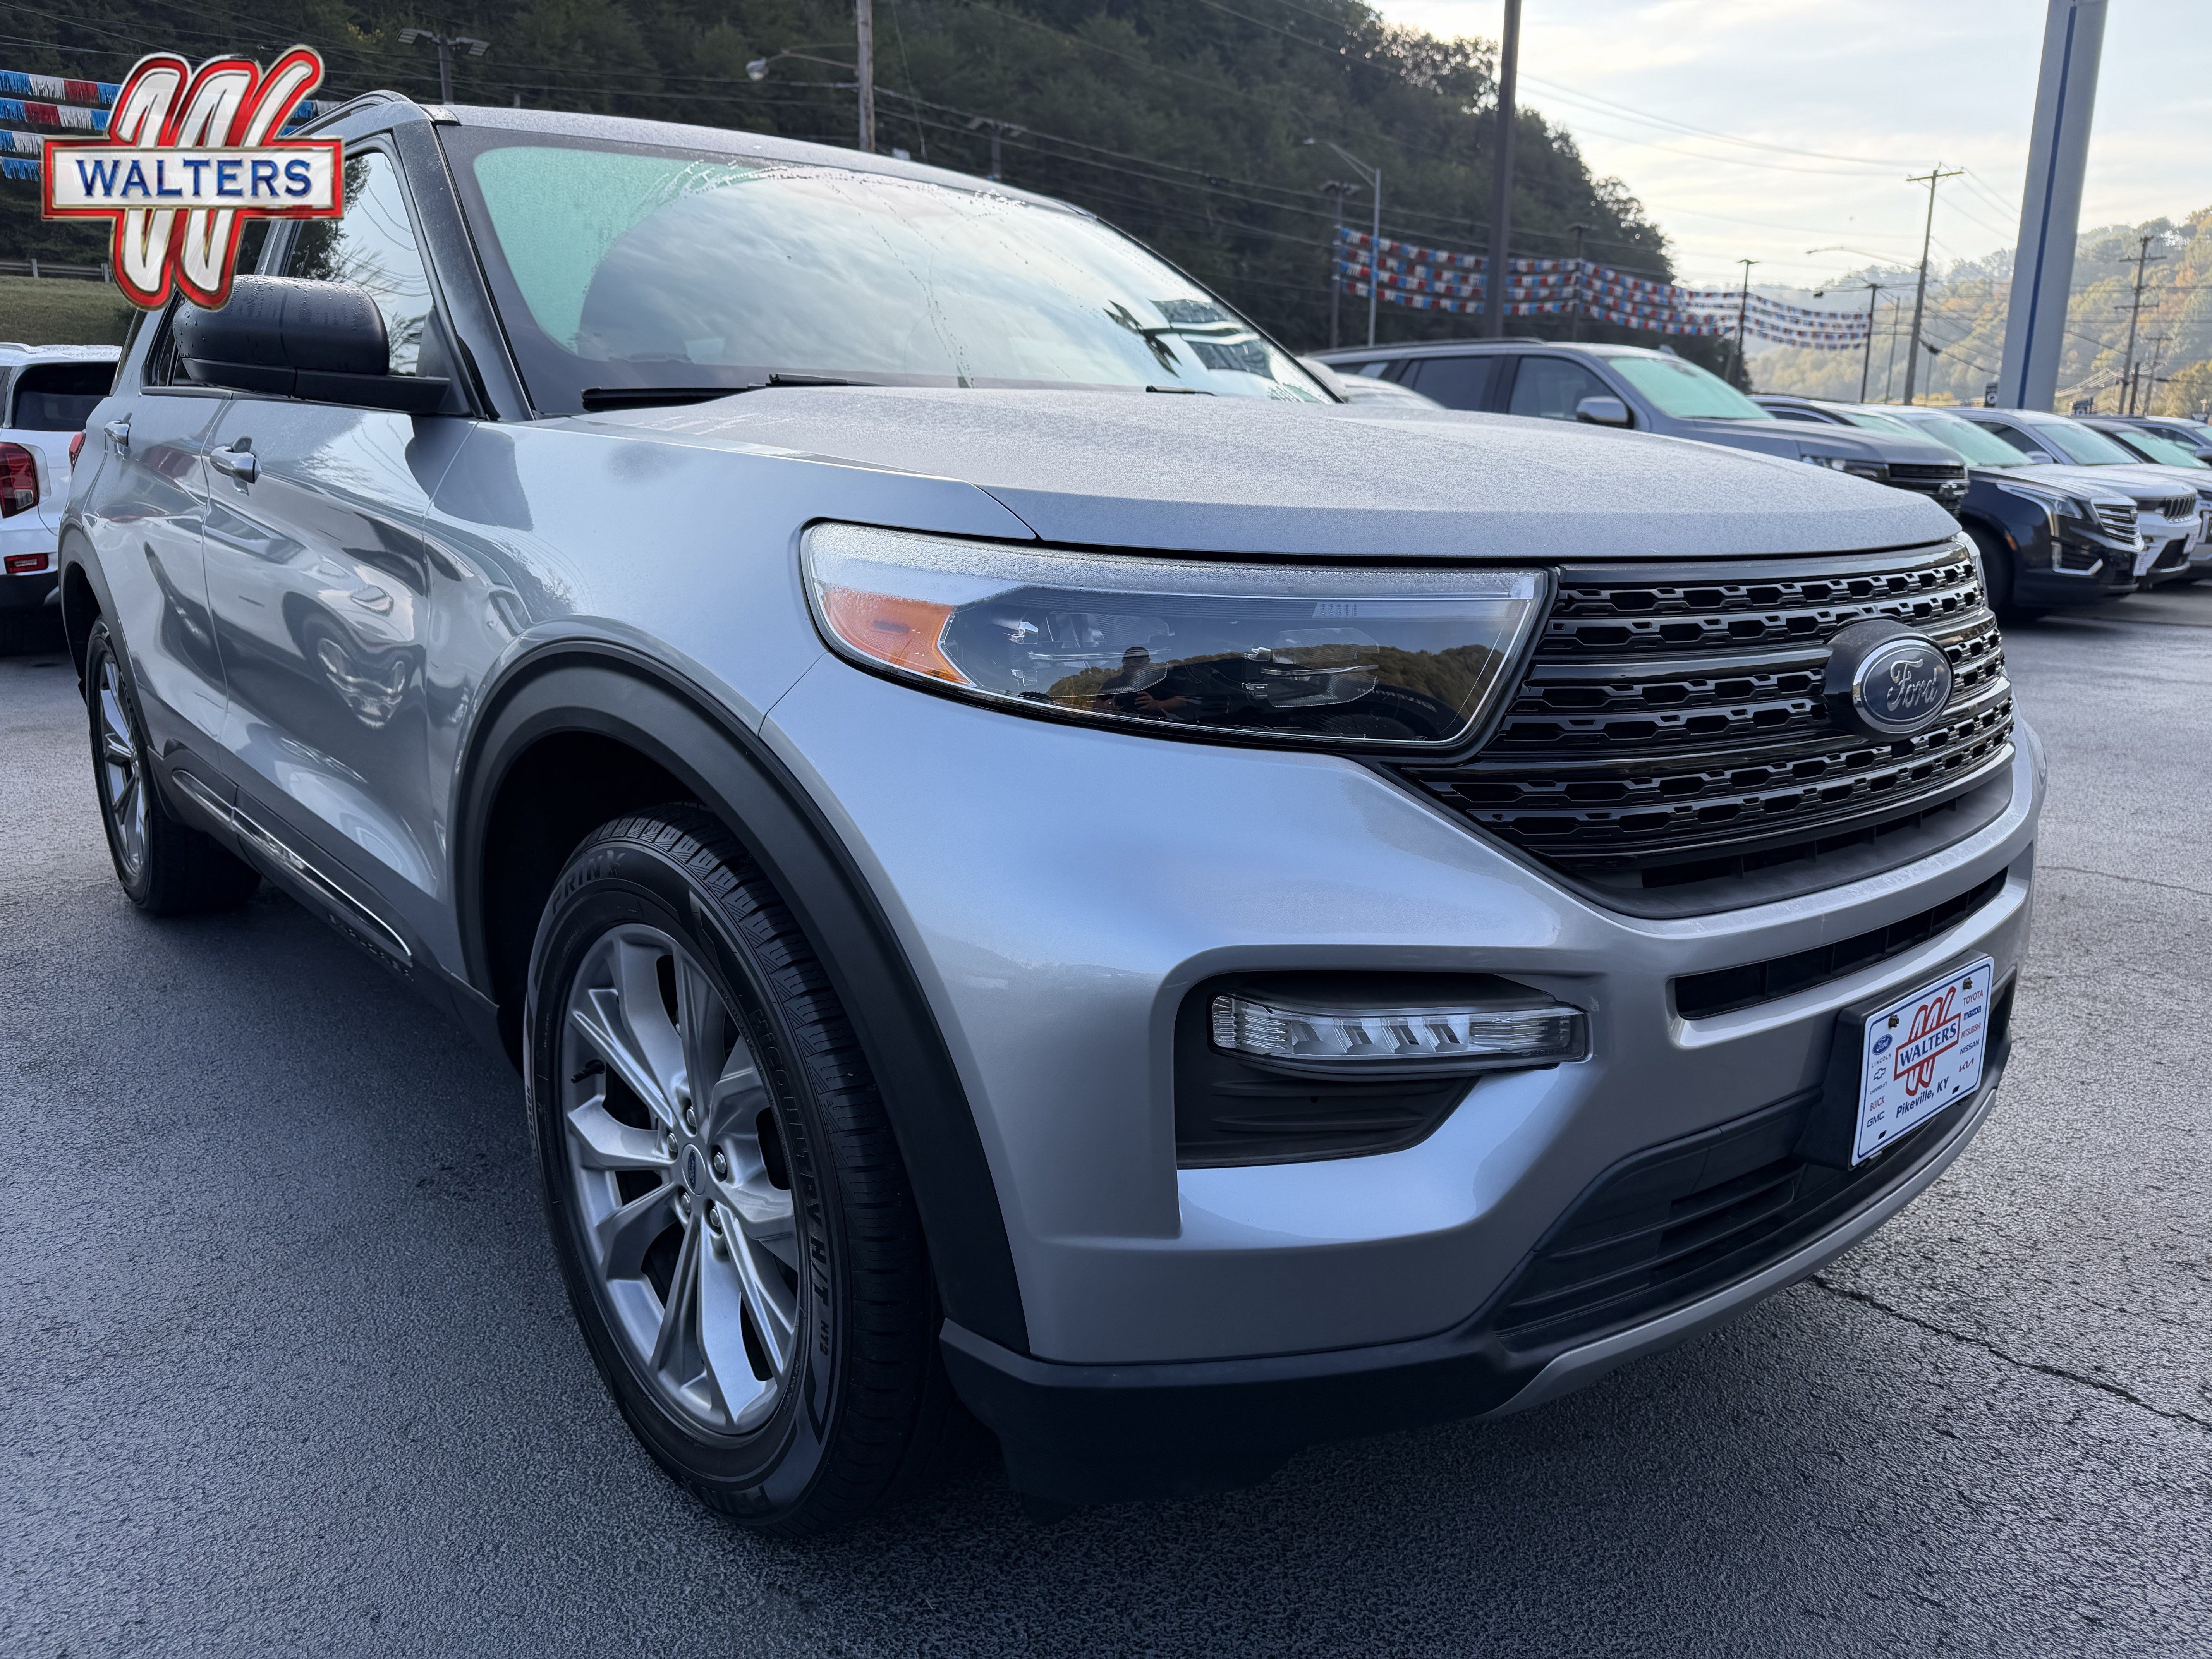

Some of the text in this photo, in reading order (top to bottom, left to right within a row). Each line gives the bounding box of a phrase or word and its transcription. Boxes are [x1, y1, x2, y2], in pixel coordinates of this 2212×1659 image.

[1886, 658, 1938, 711] Ford
[551, 849, 627, 915] PRINX
[1963, 989, 1983, 1006] TOYOTA
[1961, 1022, 1981, 1039] MITSUBISHI
[1899, 1024, 1957, 1067] WALTERS
[1960, 1038, 1980, 1055] NISSAN
[1871, 1053, 1892, 1068] LINCOLN
[1870, 1081, 1887, 1095] CHEVROLET
[1870, 1095, 1885, 1111] BUICK
[1896, 1076, 1950, 1119] Pikeville, KY
[1867, 1110, 1885, 1128] GMC
[809, 1235, 829, 1307] H/T
[819, 1319, 830, 1357] HT2
